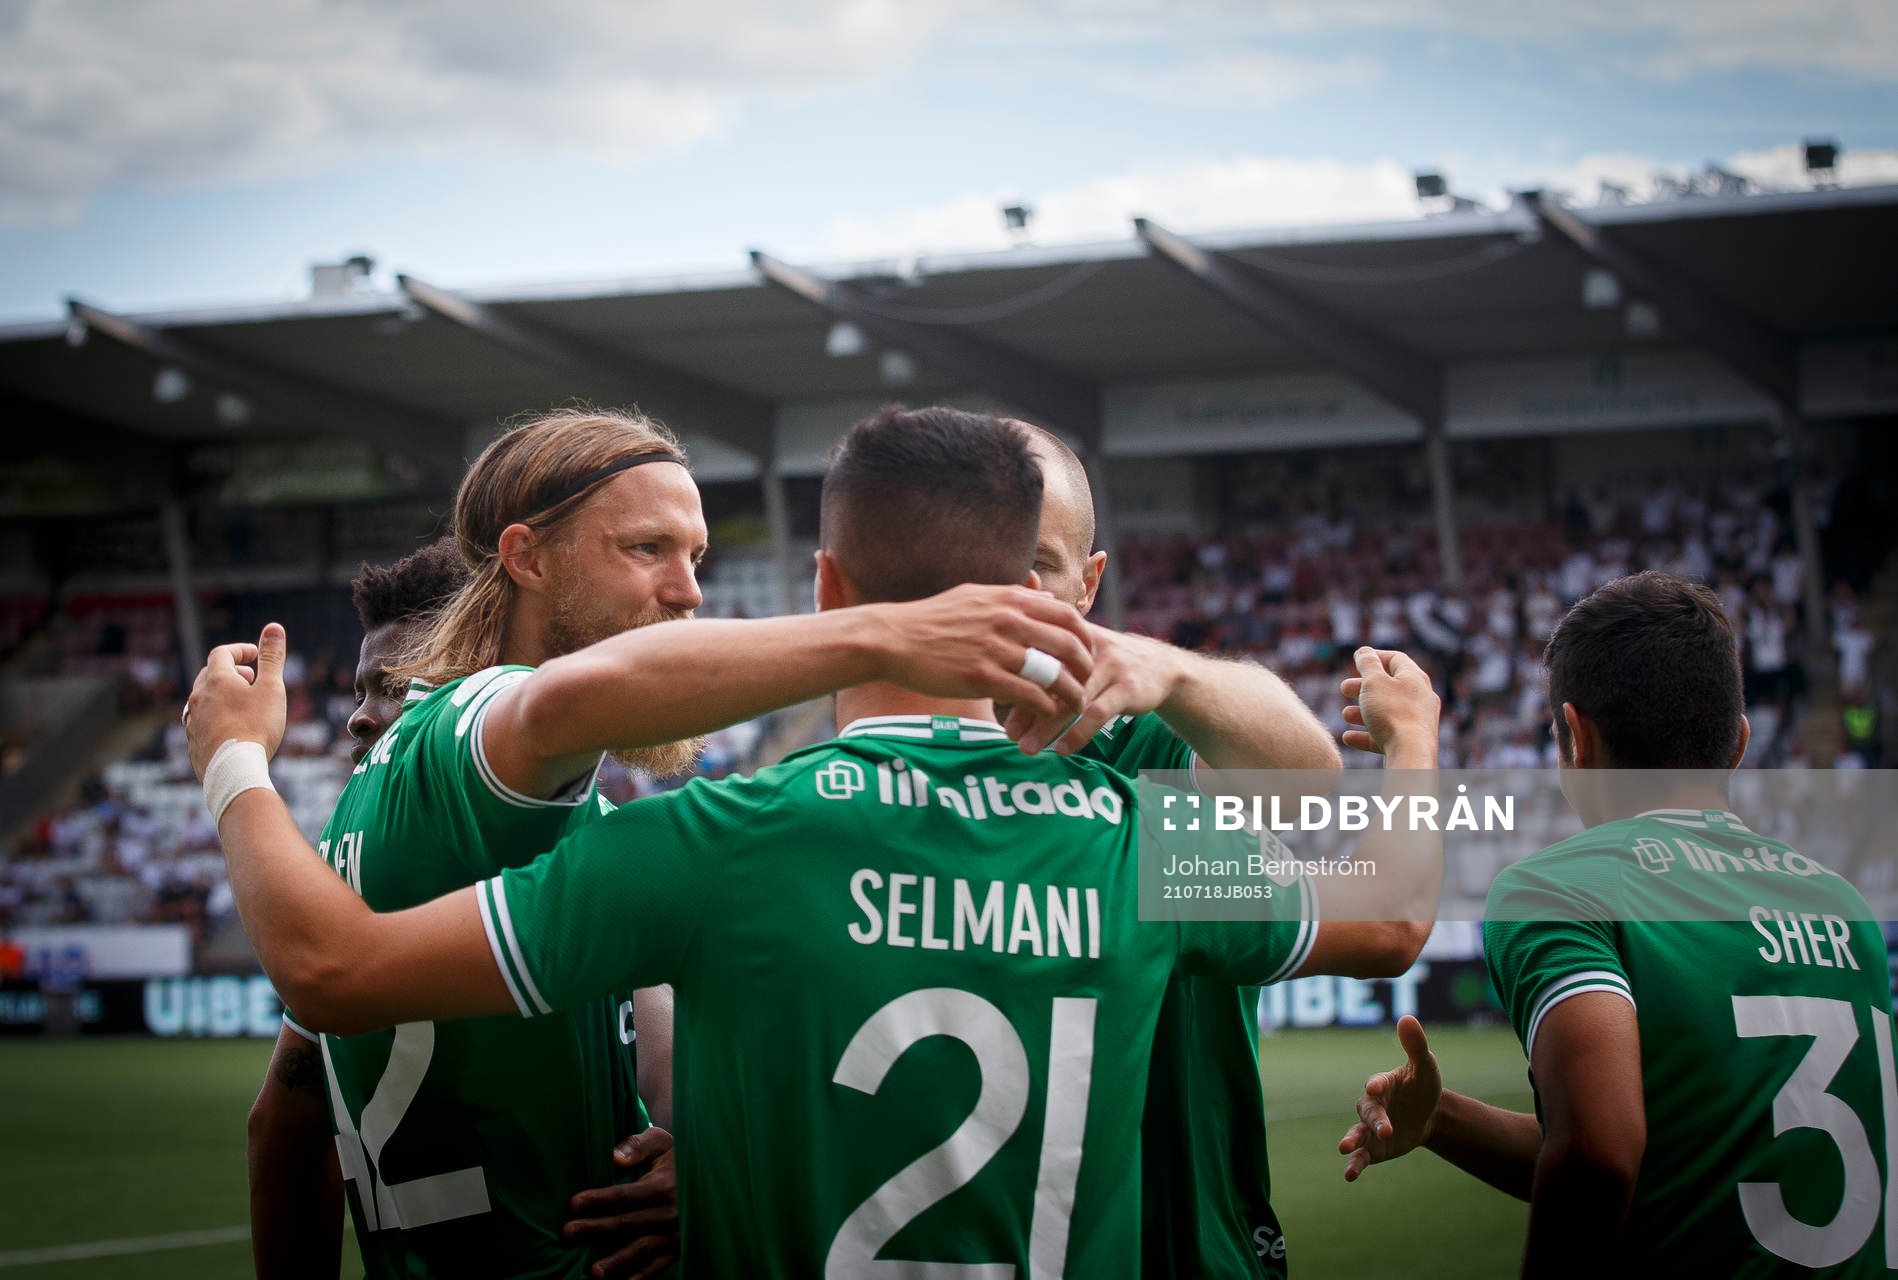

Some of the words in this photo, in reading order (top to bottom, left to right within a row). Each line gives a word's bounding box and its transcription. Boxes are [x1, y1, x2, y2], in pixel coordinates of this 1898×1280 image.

[876, 757, 1124, 825] limitado
[1671, 837, 1838, 877] limita
[848, 868, 1100, 960] SELMANI
[1750, 905, 1861, 970] SHER
[825, 987, 1098, 1280] 21
[1731, 995, 1898, 1270] 31
